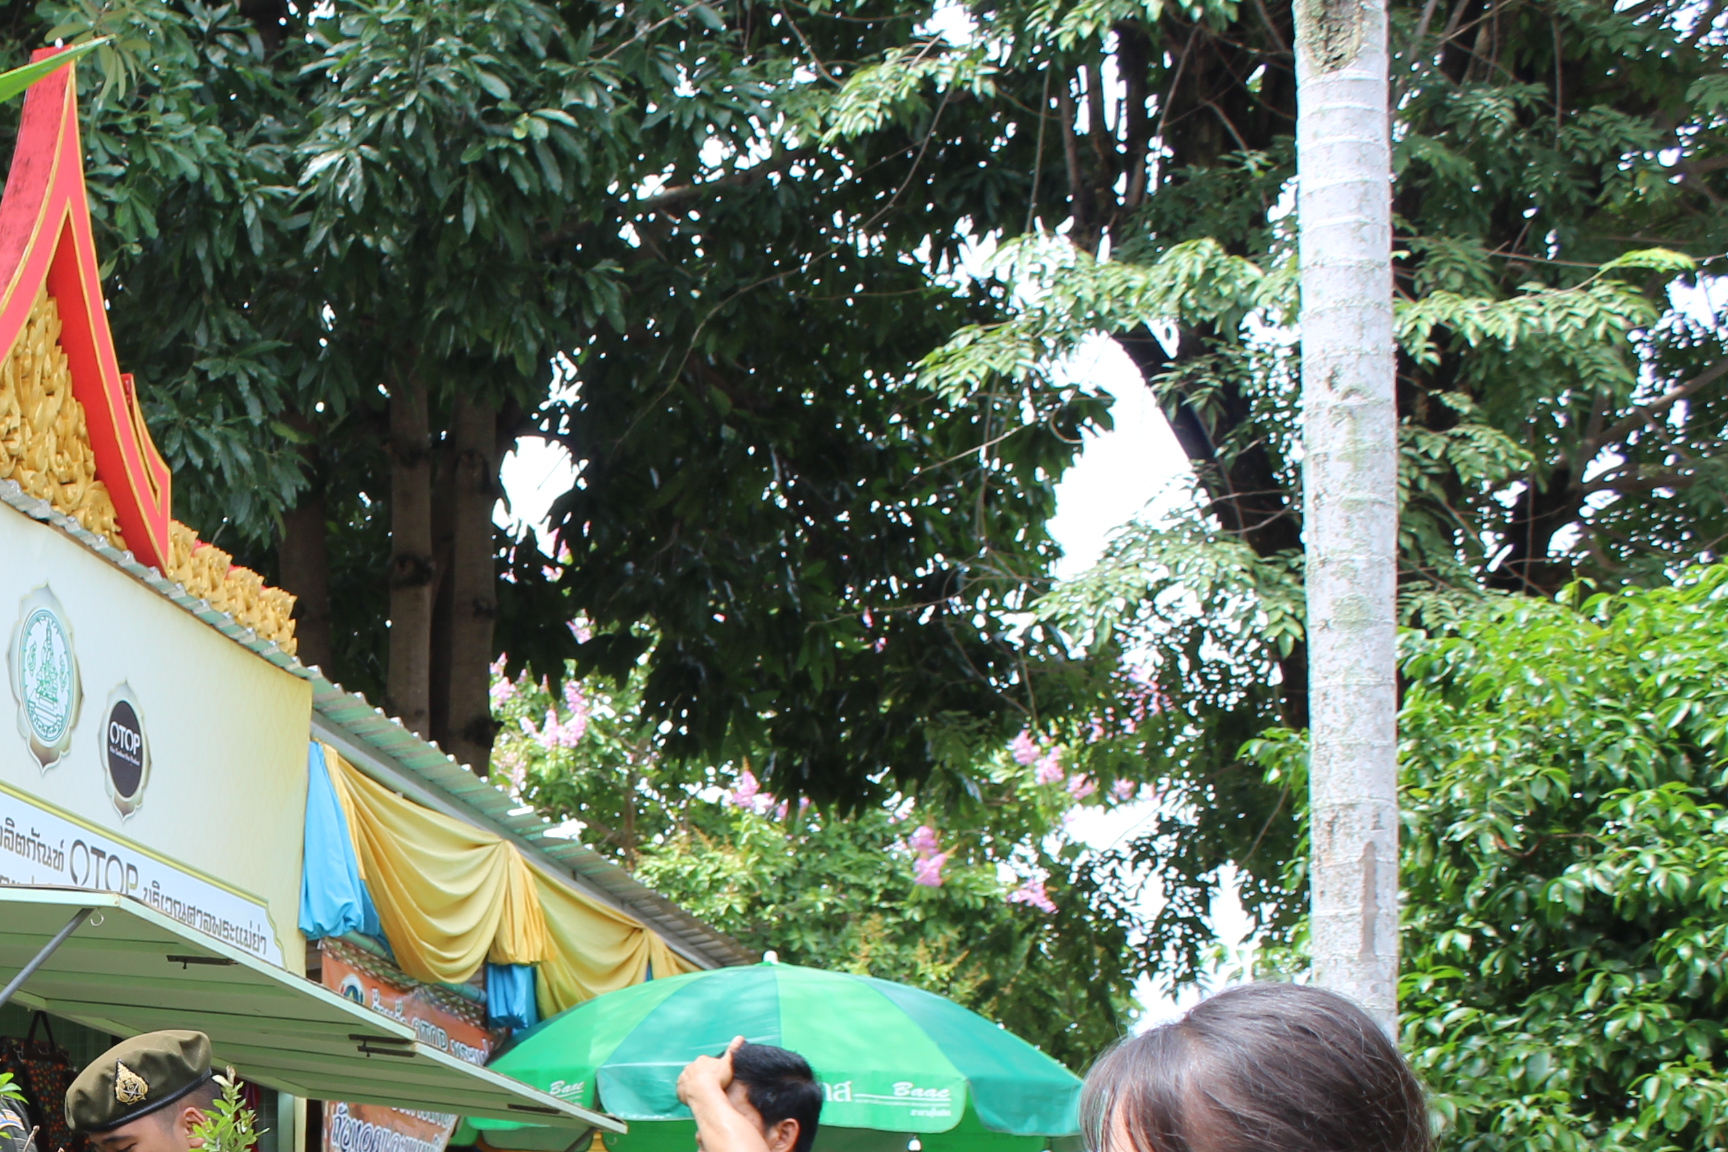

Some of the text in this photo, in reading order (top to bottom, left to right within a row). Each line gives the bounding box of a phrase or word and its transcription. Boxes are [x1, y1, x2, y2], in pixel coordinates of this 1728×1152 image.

[110, 721, 141, 755] OTOP
[70, 839, 139, 896] OTOP
[892, 1081, 951, 1098] Baac
